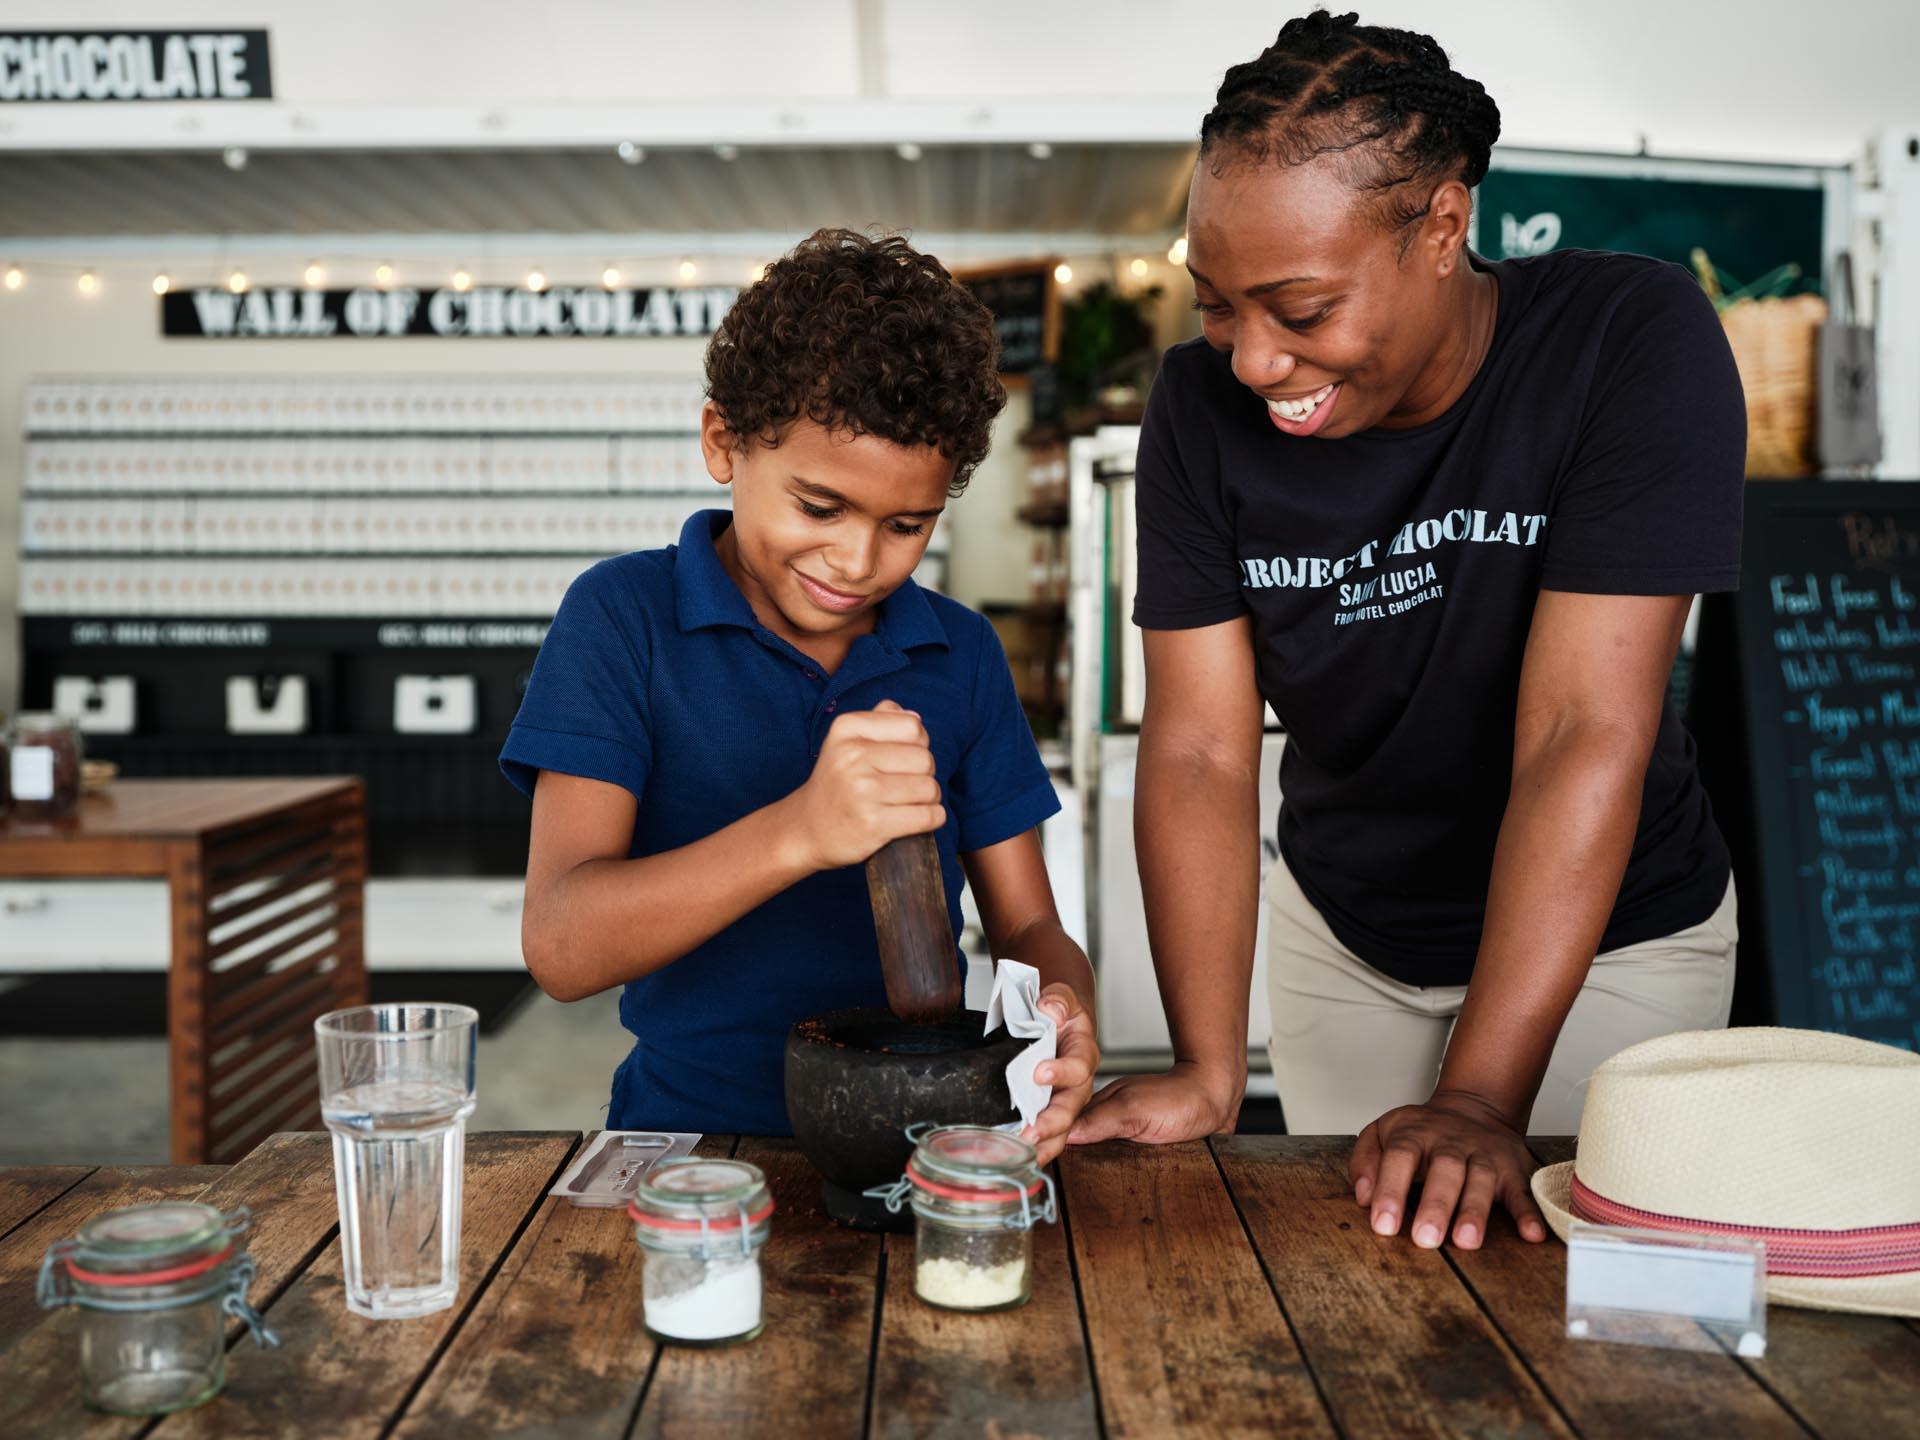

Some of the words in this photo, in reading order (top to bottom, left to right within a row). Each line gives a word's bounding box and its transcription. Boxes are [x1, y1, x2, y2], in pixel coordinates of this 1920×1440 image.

[0, 34, 251, 98] CHOCOLATE
[192, 287, 338, 335] WALL
[344, 287, 420, 335] OF
[1239, 540, 1378, 588] ROJECT
[1386, 509, 1547, 557] HOCOLAT
[1355, 605, 1386, 621] HOTEL
[1388, 585, 1444, 615] CHOCOLAT
[1381, 561, 1437, 597] LUCIA
